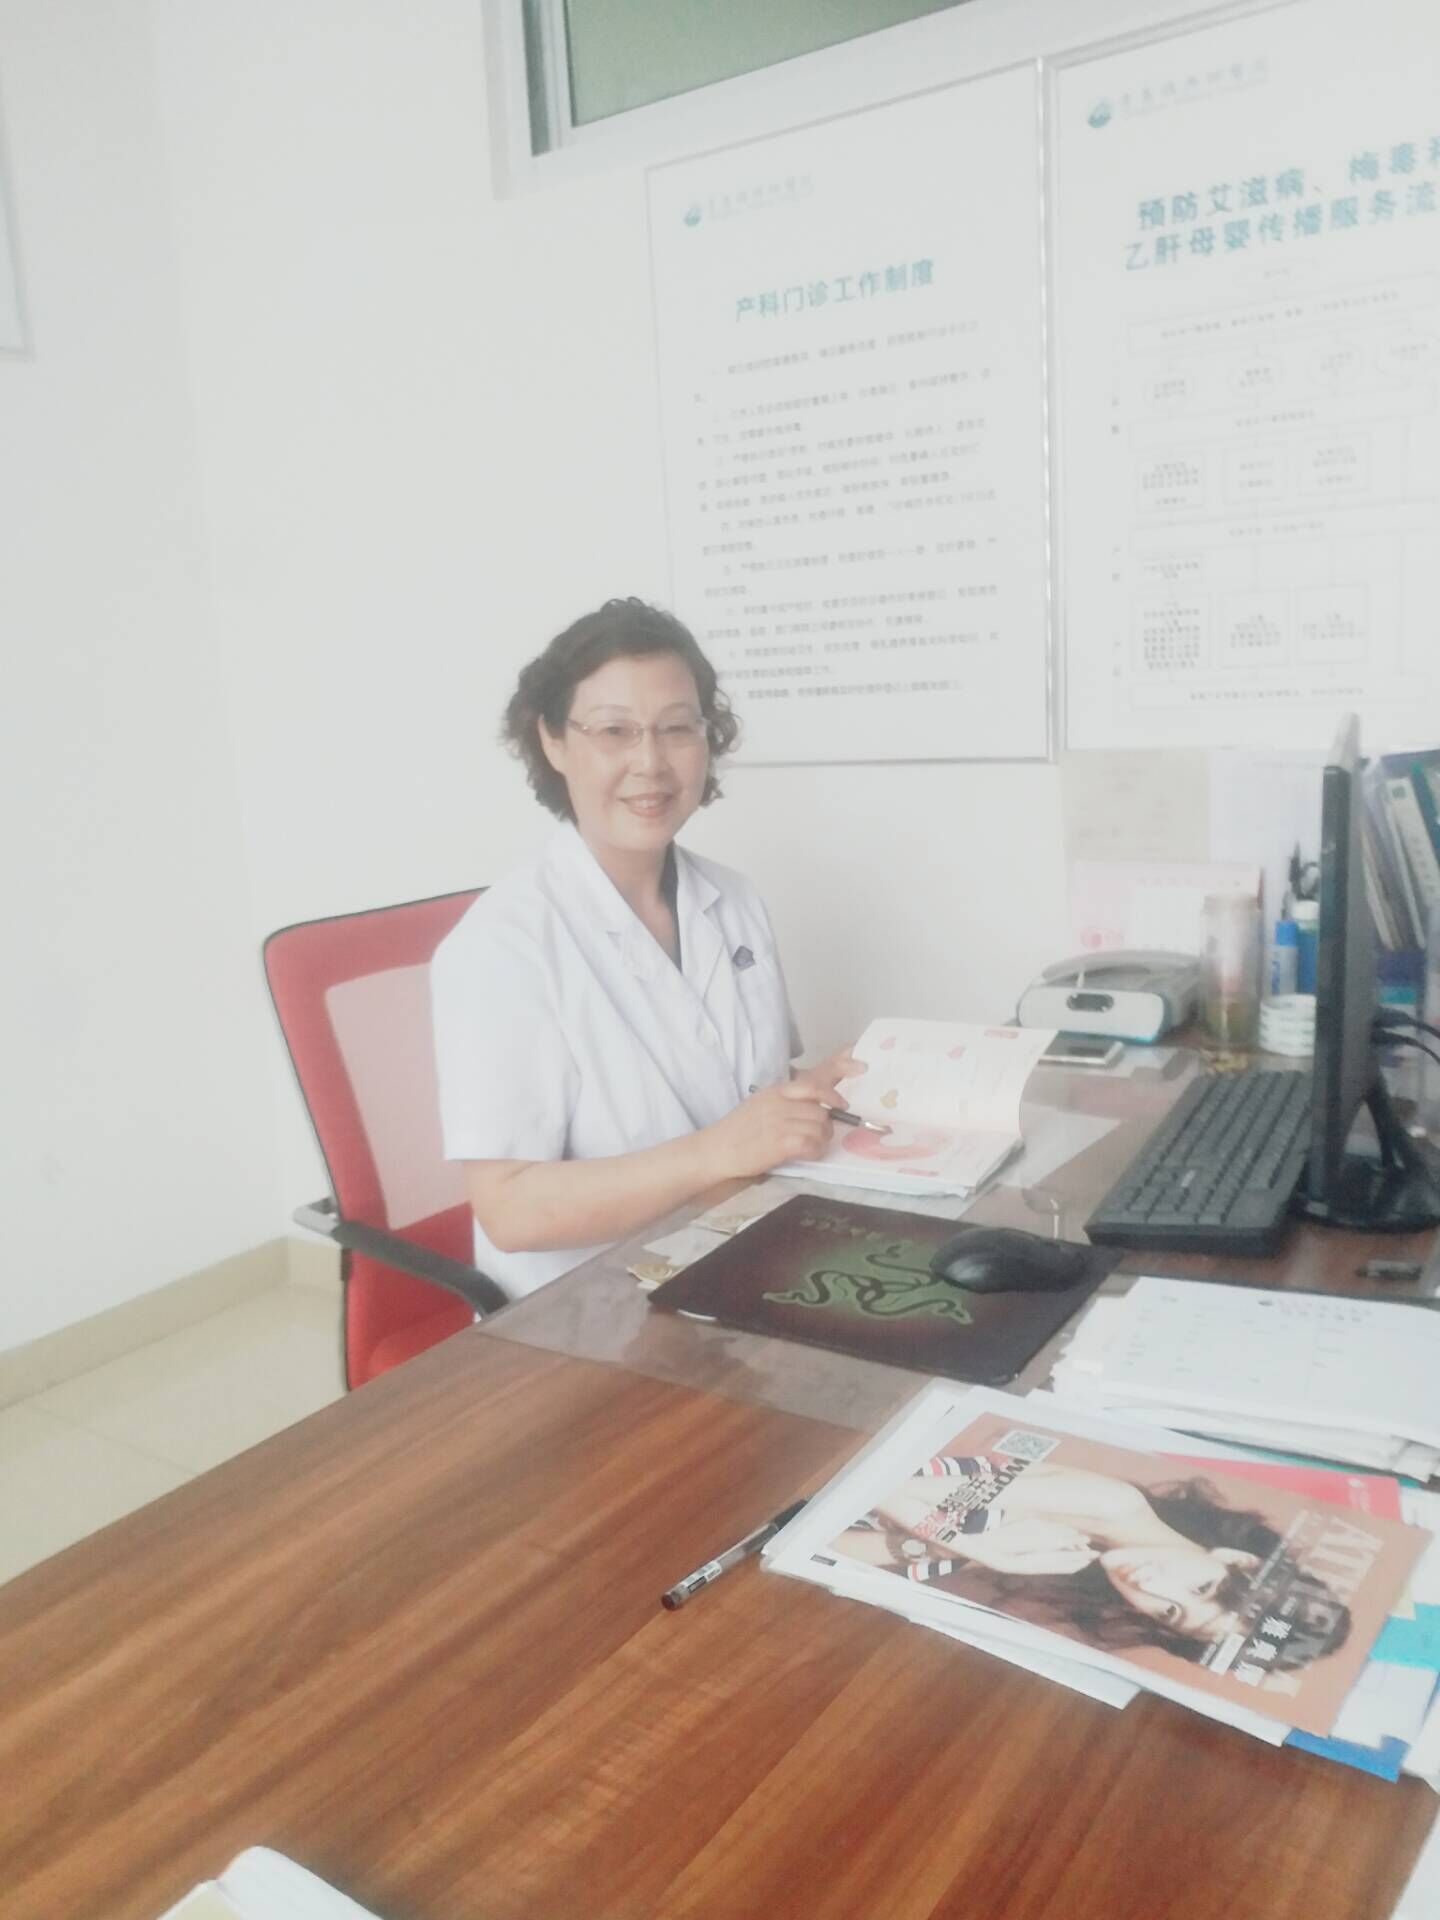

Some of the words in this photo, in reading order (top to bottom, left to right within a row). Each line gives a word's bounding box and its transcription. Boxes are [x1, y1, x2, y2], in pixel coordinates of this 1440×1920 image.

[735, 257, 934, 321] 产科门诊工作制度
